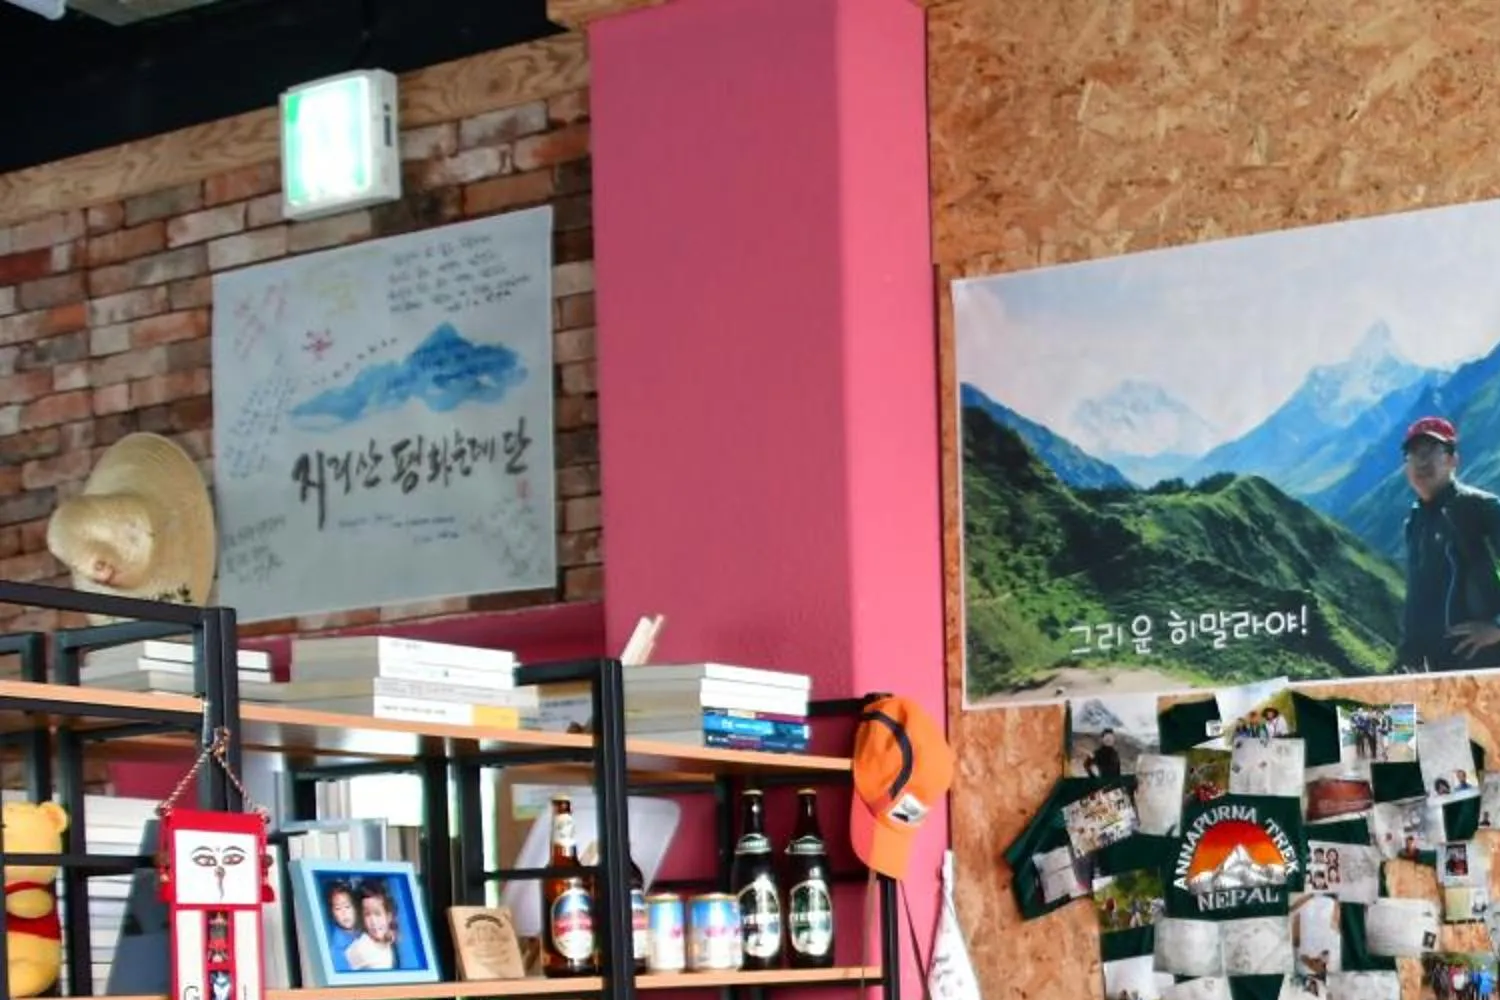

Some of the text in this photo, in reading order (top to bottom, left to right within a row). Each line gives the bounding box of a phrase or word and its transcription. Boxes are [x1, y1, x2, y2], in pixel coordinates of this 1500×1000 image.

[1069, 604, 1309, 655] 그리운 히말라야!
[1173, 804, 1300, 891] ANNAPURNA TREK
[1197, 887, 1280, 912] NEPAL
